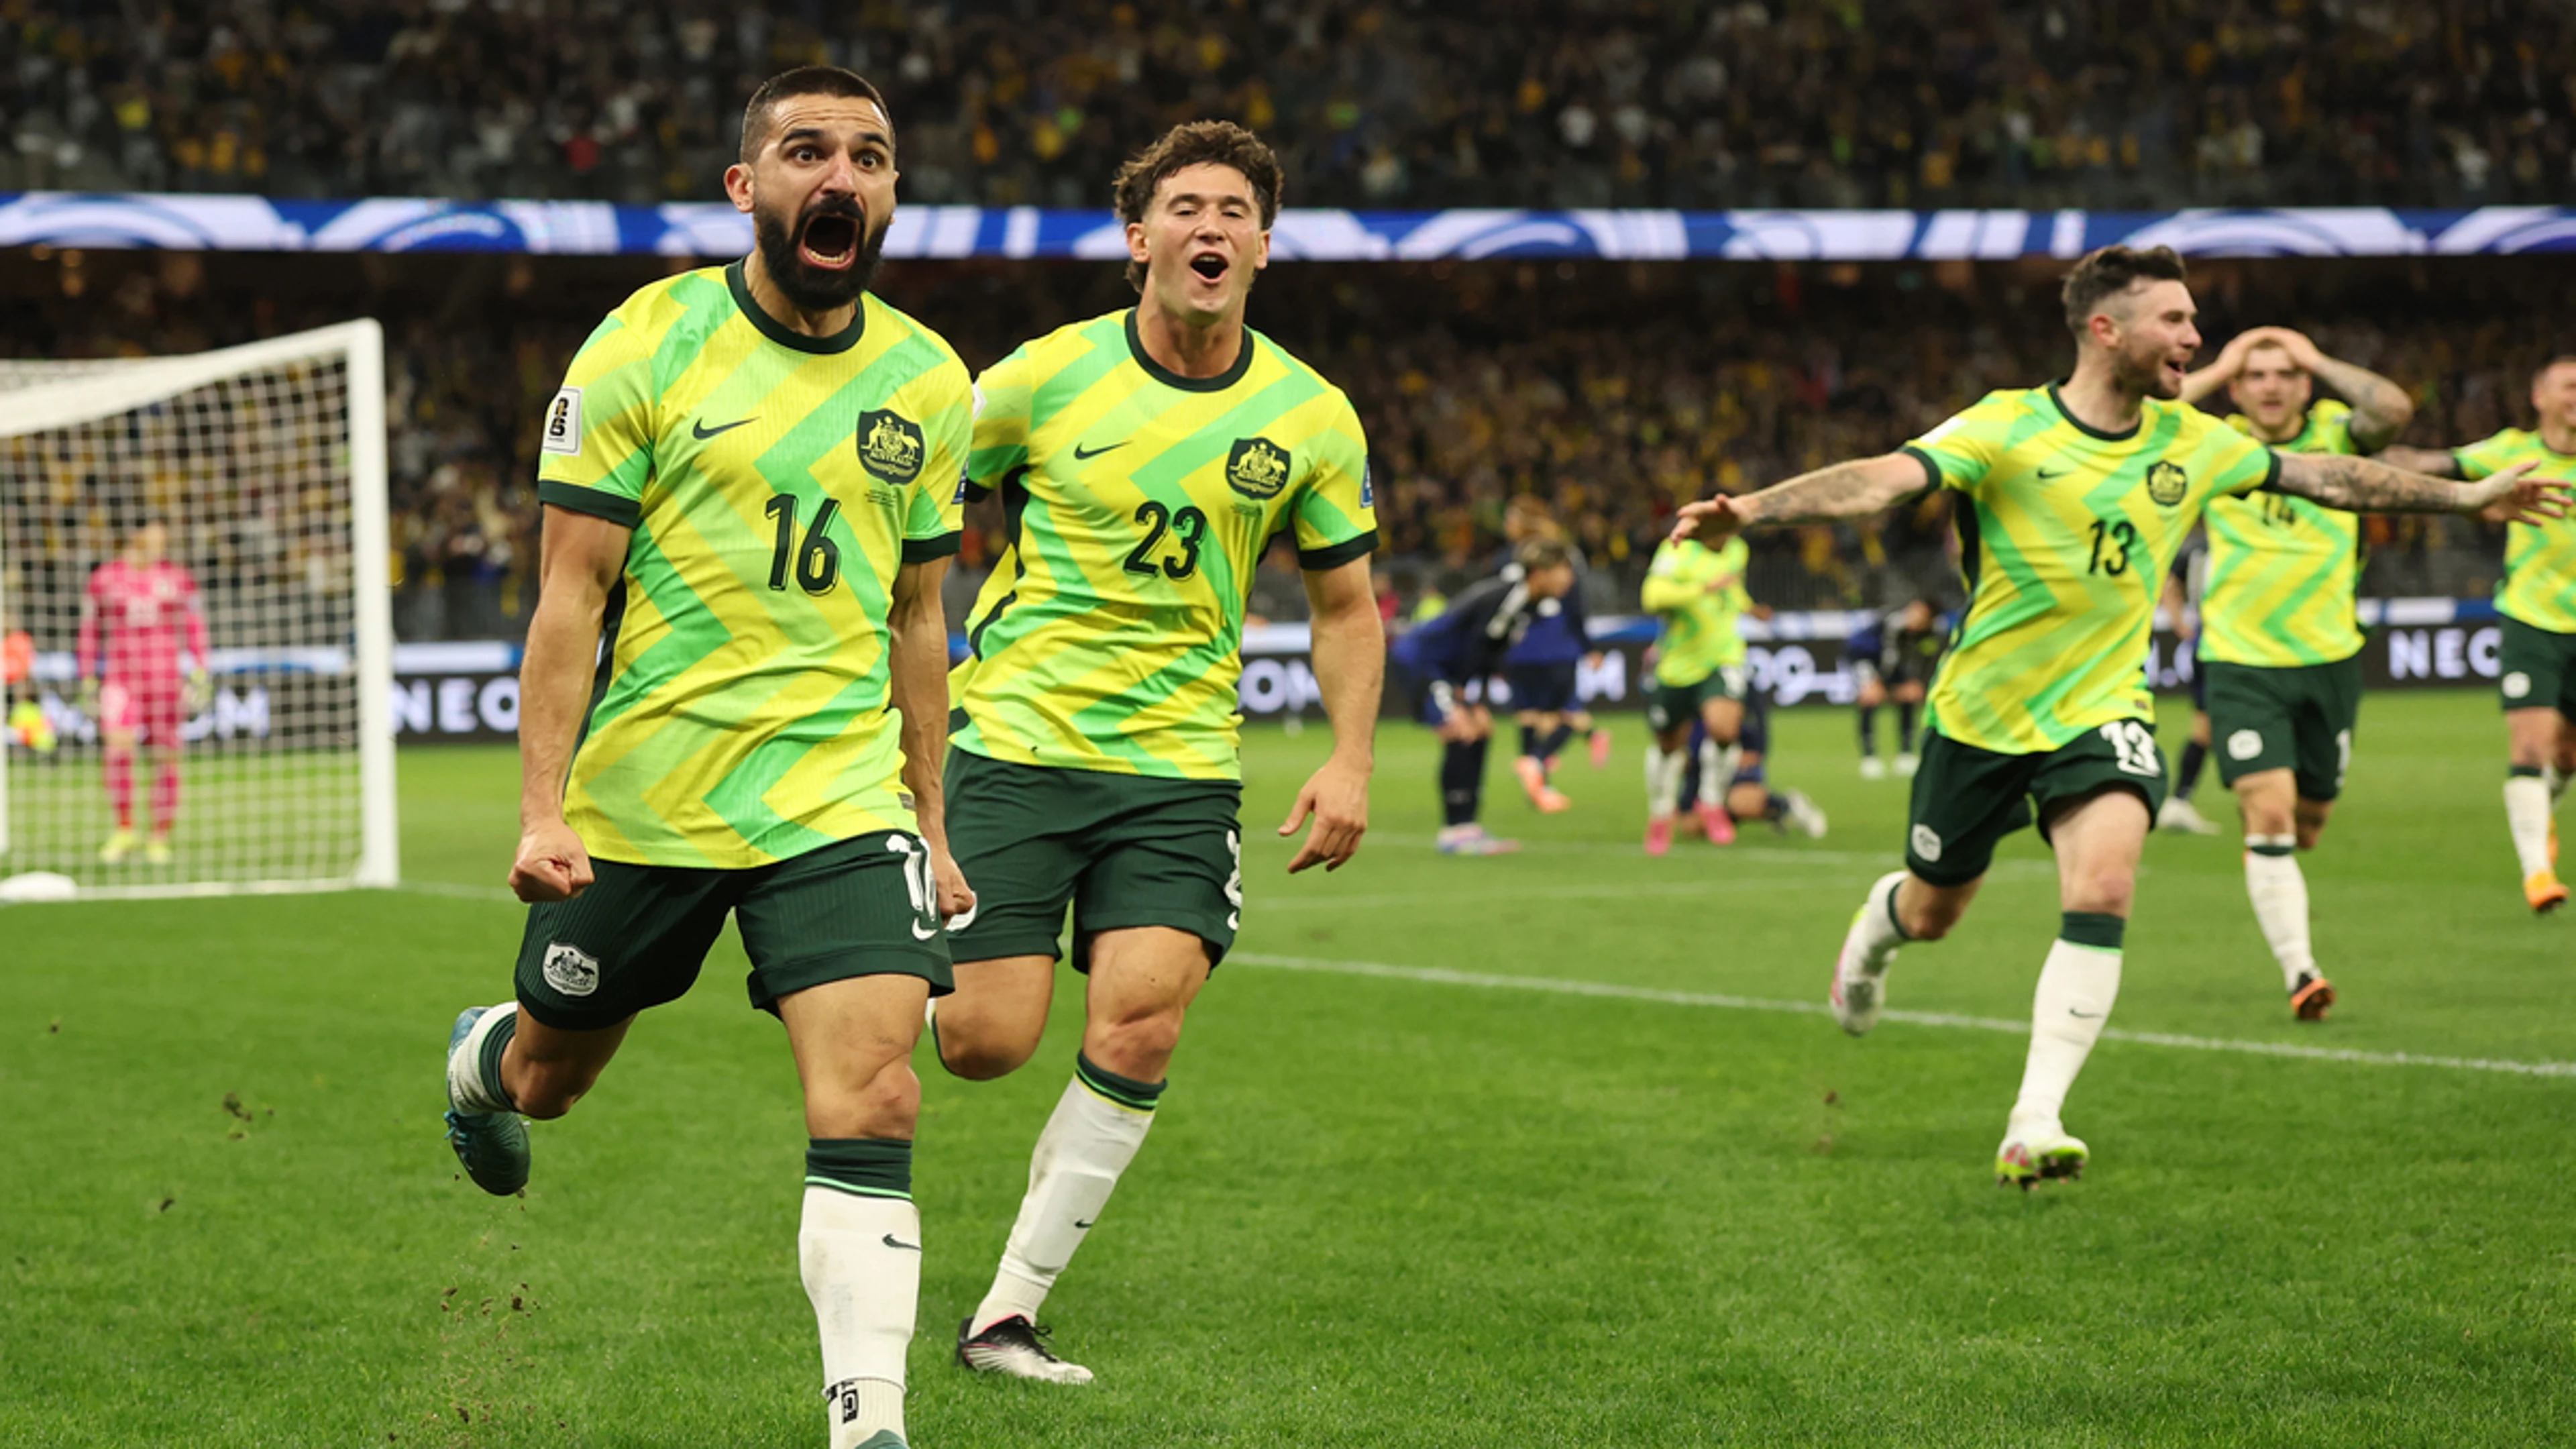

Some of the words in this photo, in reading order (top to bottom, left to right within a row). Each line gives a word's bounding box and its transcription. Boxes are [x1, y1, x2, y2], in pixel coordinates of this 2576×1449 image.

[764, 493, 842, 597] 16
[1122, 500, 1207, 582] 23
[2088, 519, 2137, 578] 13
